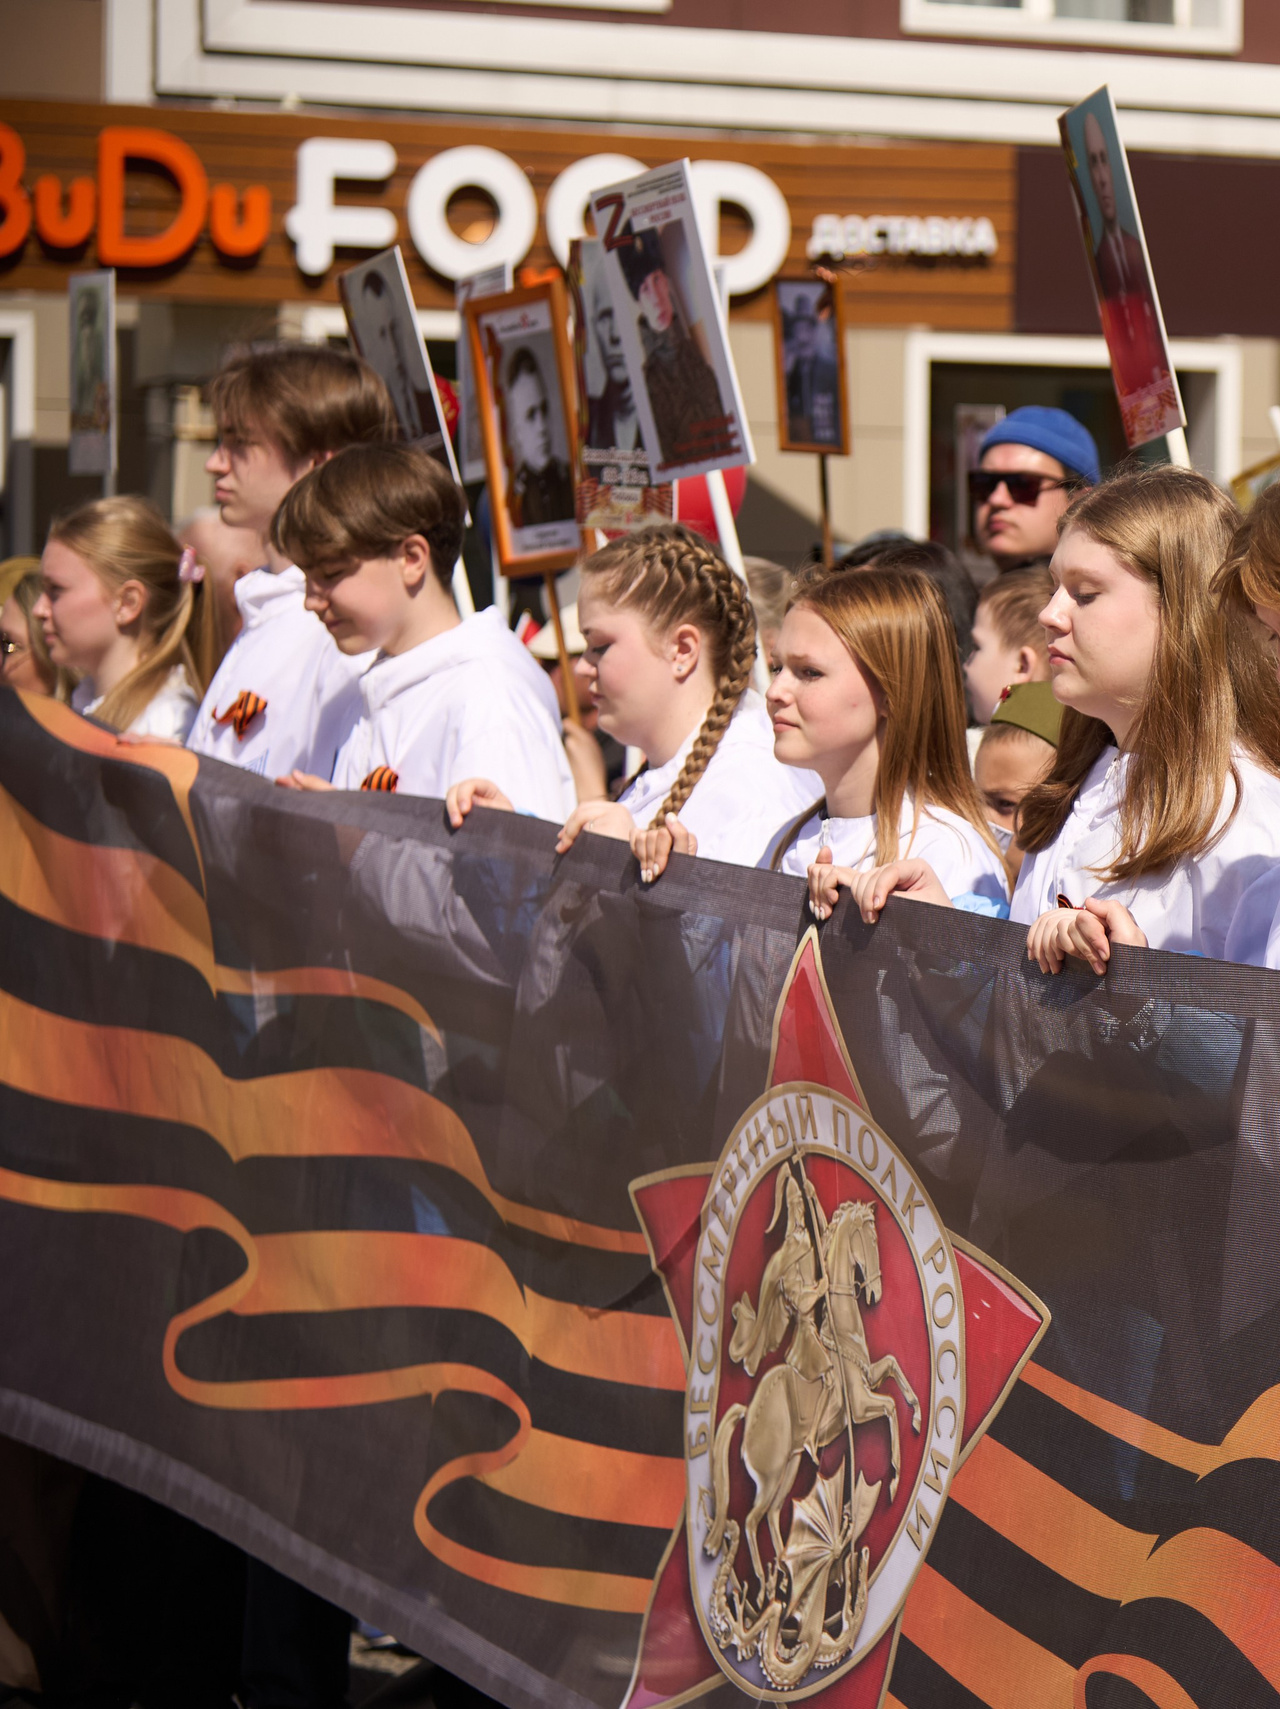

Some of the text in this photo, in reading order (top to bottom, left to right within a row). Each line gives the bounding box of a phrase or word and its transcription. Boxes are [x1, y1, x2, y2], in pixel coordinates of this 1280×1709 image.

[595, 191, 634, 253] Z
[806, 213, 998, 259] ДОСТАВКА
[689, 1091, 960, 1553] БЕССМЕРТНЫЙ ПОЛК РОССИИ
